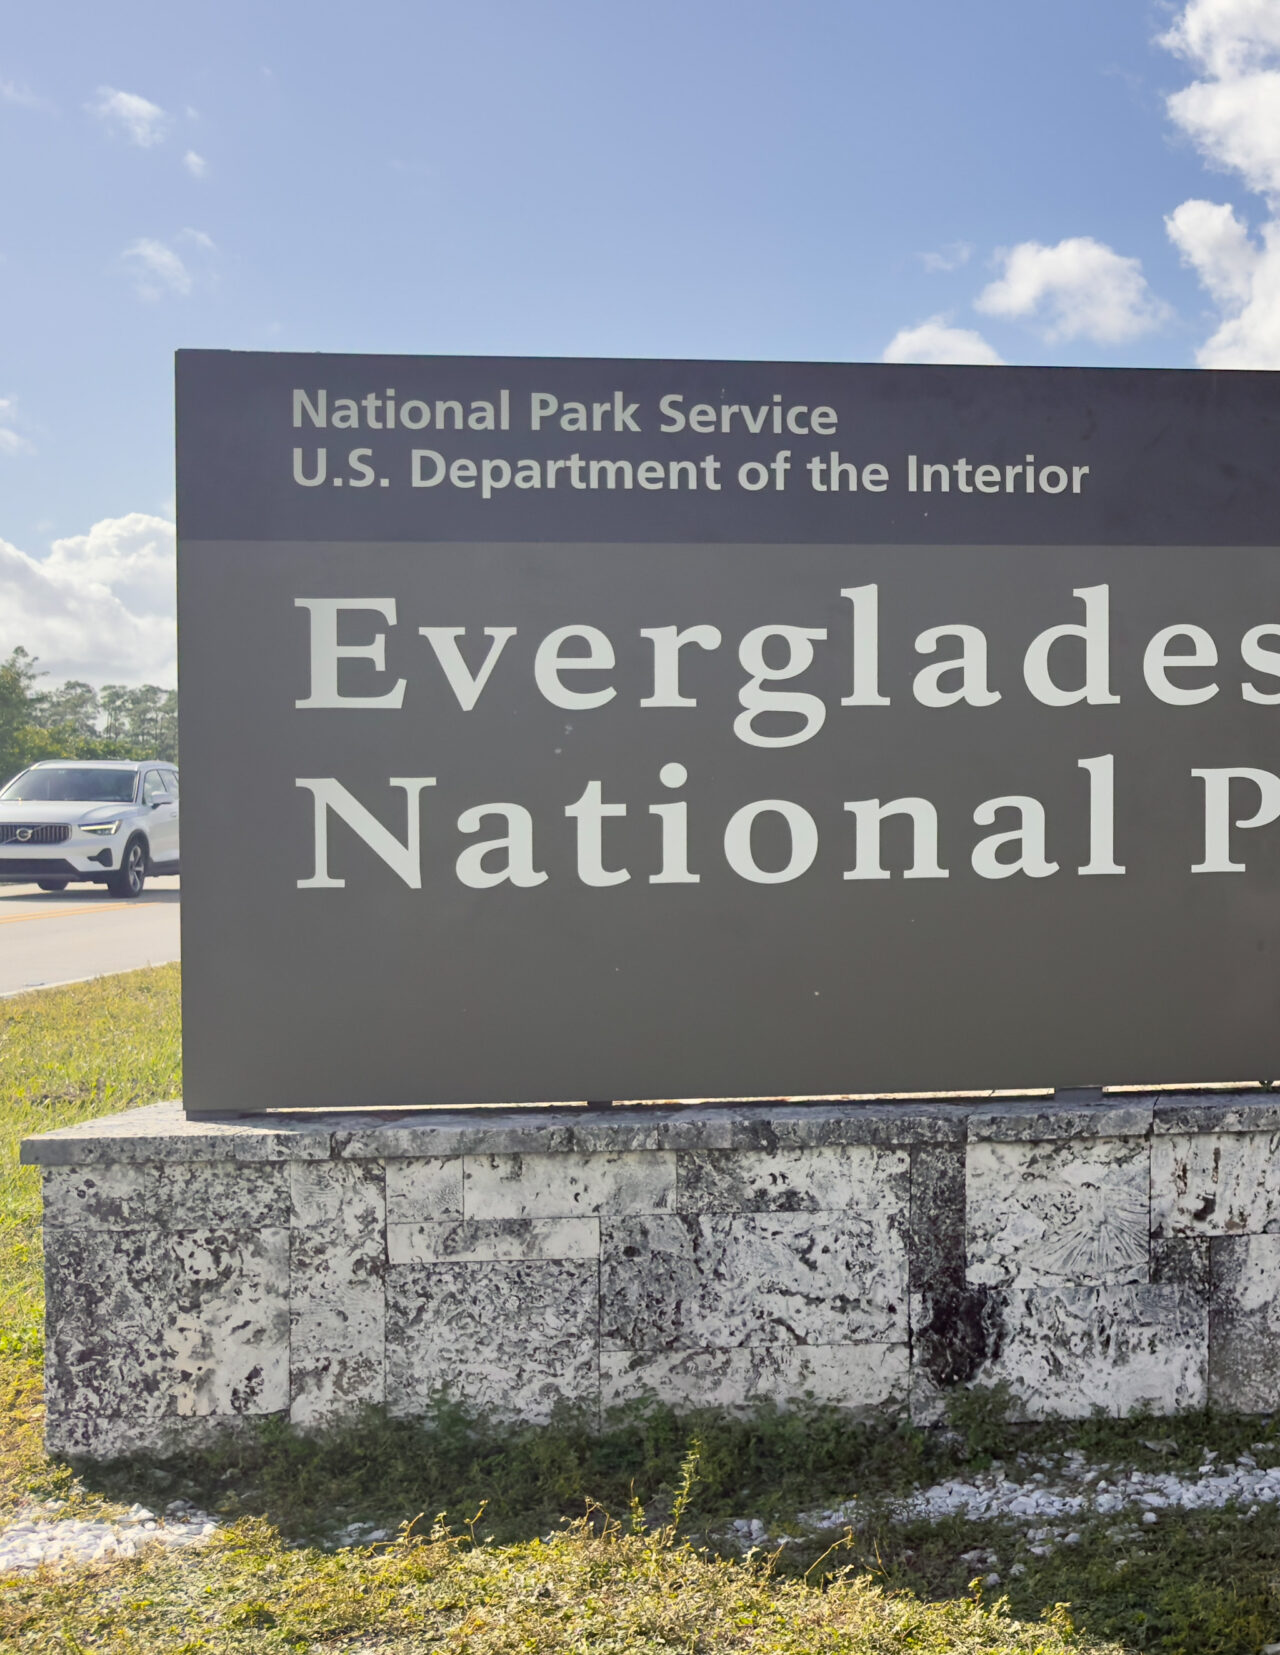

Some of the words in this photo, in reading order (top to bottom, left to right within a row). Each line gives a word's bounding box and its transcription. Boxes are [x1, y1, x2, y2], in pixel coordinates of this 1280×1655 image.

[293, 388, 510, 431] National
[531, 391, 642, 432] Park
[659, 394, 838, 435] Service
[293, 448, 390, 488] U.S.
[411, 449, 721, 499] Department
[738, 450, 792, 491] of
[806, 451, 889, 492] the
[908, 454, 1090, 494] Interior
[294, 754, 1126, 890] National
